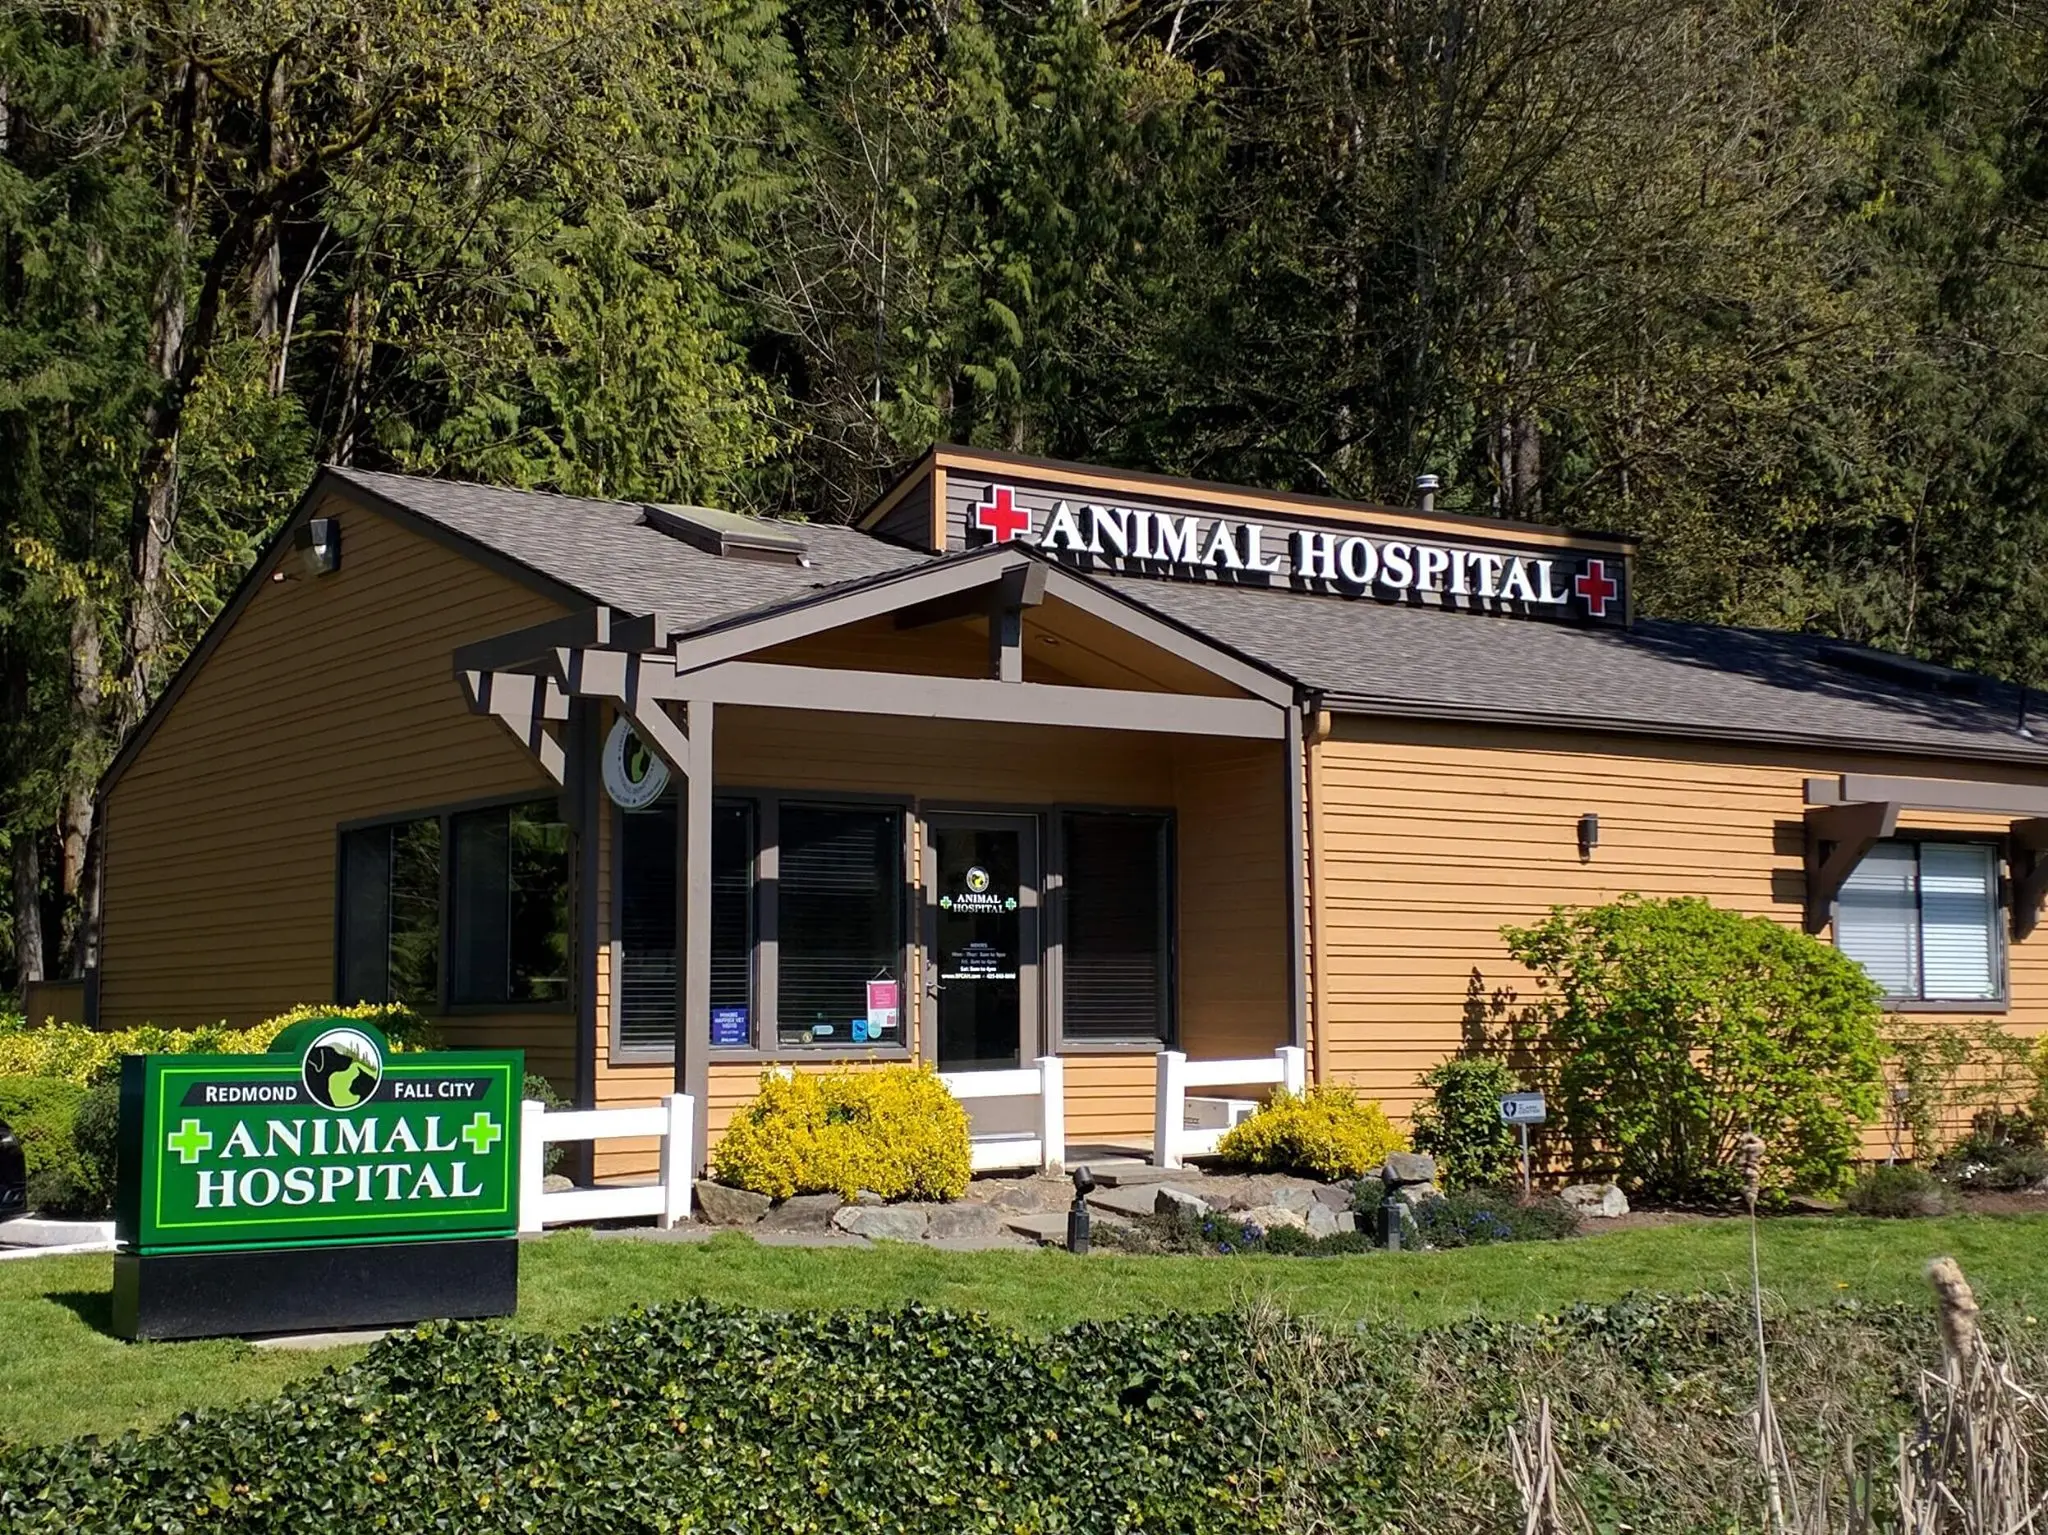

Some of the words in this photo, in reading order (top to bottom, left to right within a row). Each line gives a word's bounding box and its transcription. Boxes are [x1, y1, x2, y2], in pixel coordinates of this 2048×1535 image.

[1040, 499, 1283, 573] ANIMAL
[1296, 530, 1569, 604] HOSPITAL
[956, 894, 1001, 903] ANIMAL
[953, 903, 1005, 913] HOSPITAL
[205, 1085, 297, 1103] REDMOND
[394, 1081, 435, 1098] FALL
[438, 1080, 475, 1097] CITY
[218, 1115, 458, 1158] ANIMAL
[194, 1161, 484, 1208] HOSPITAL
